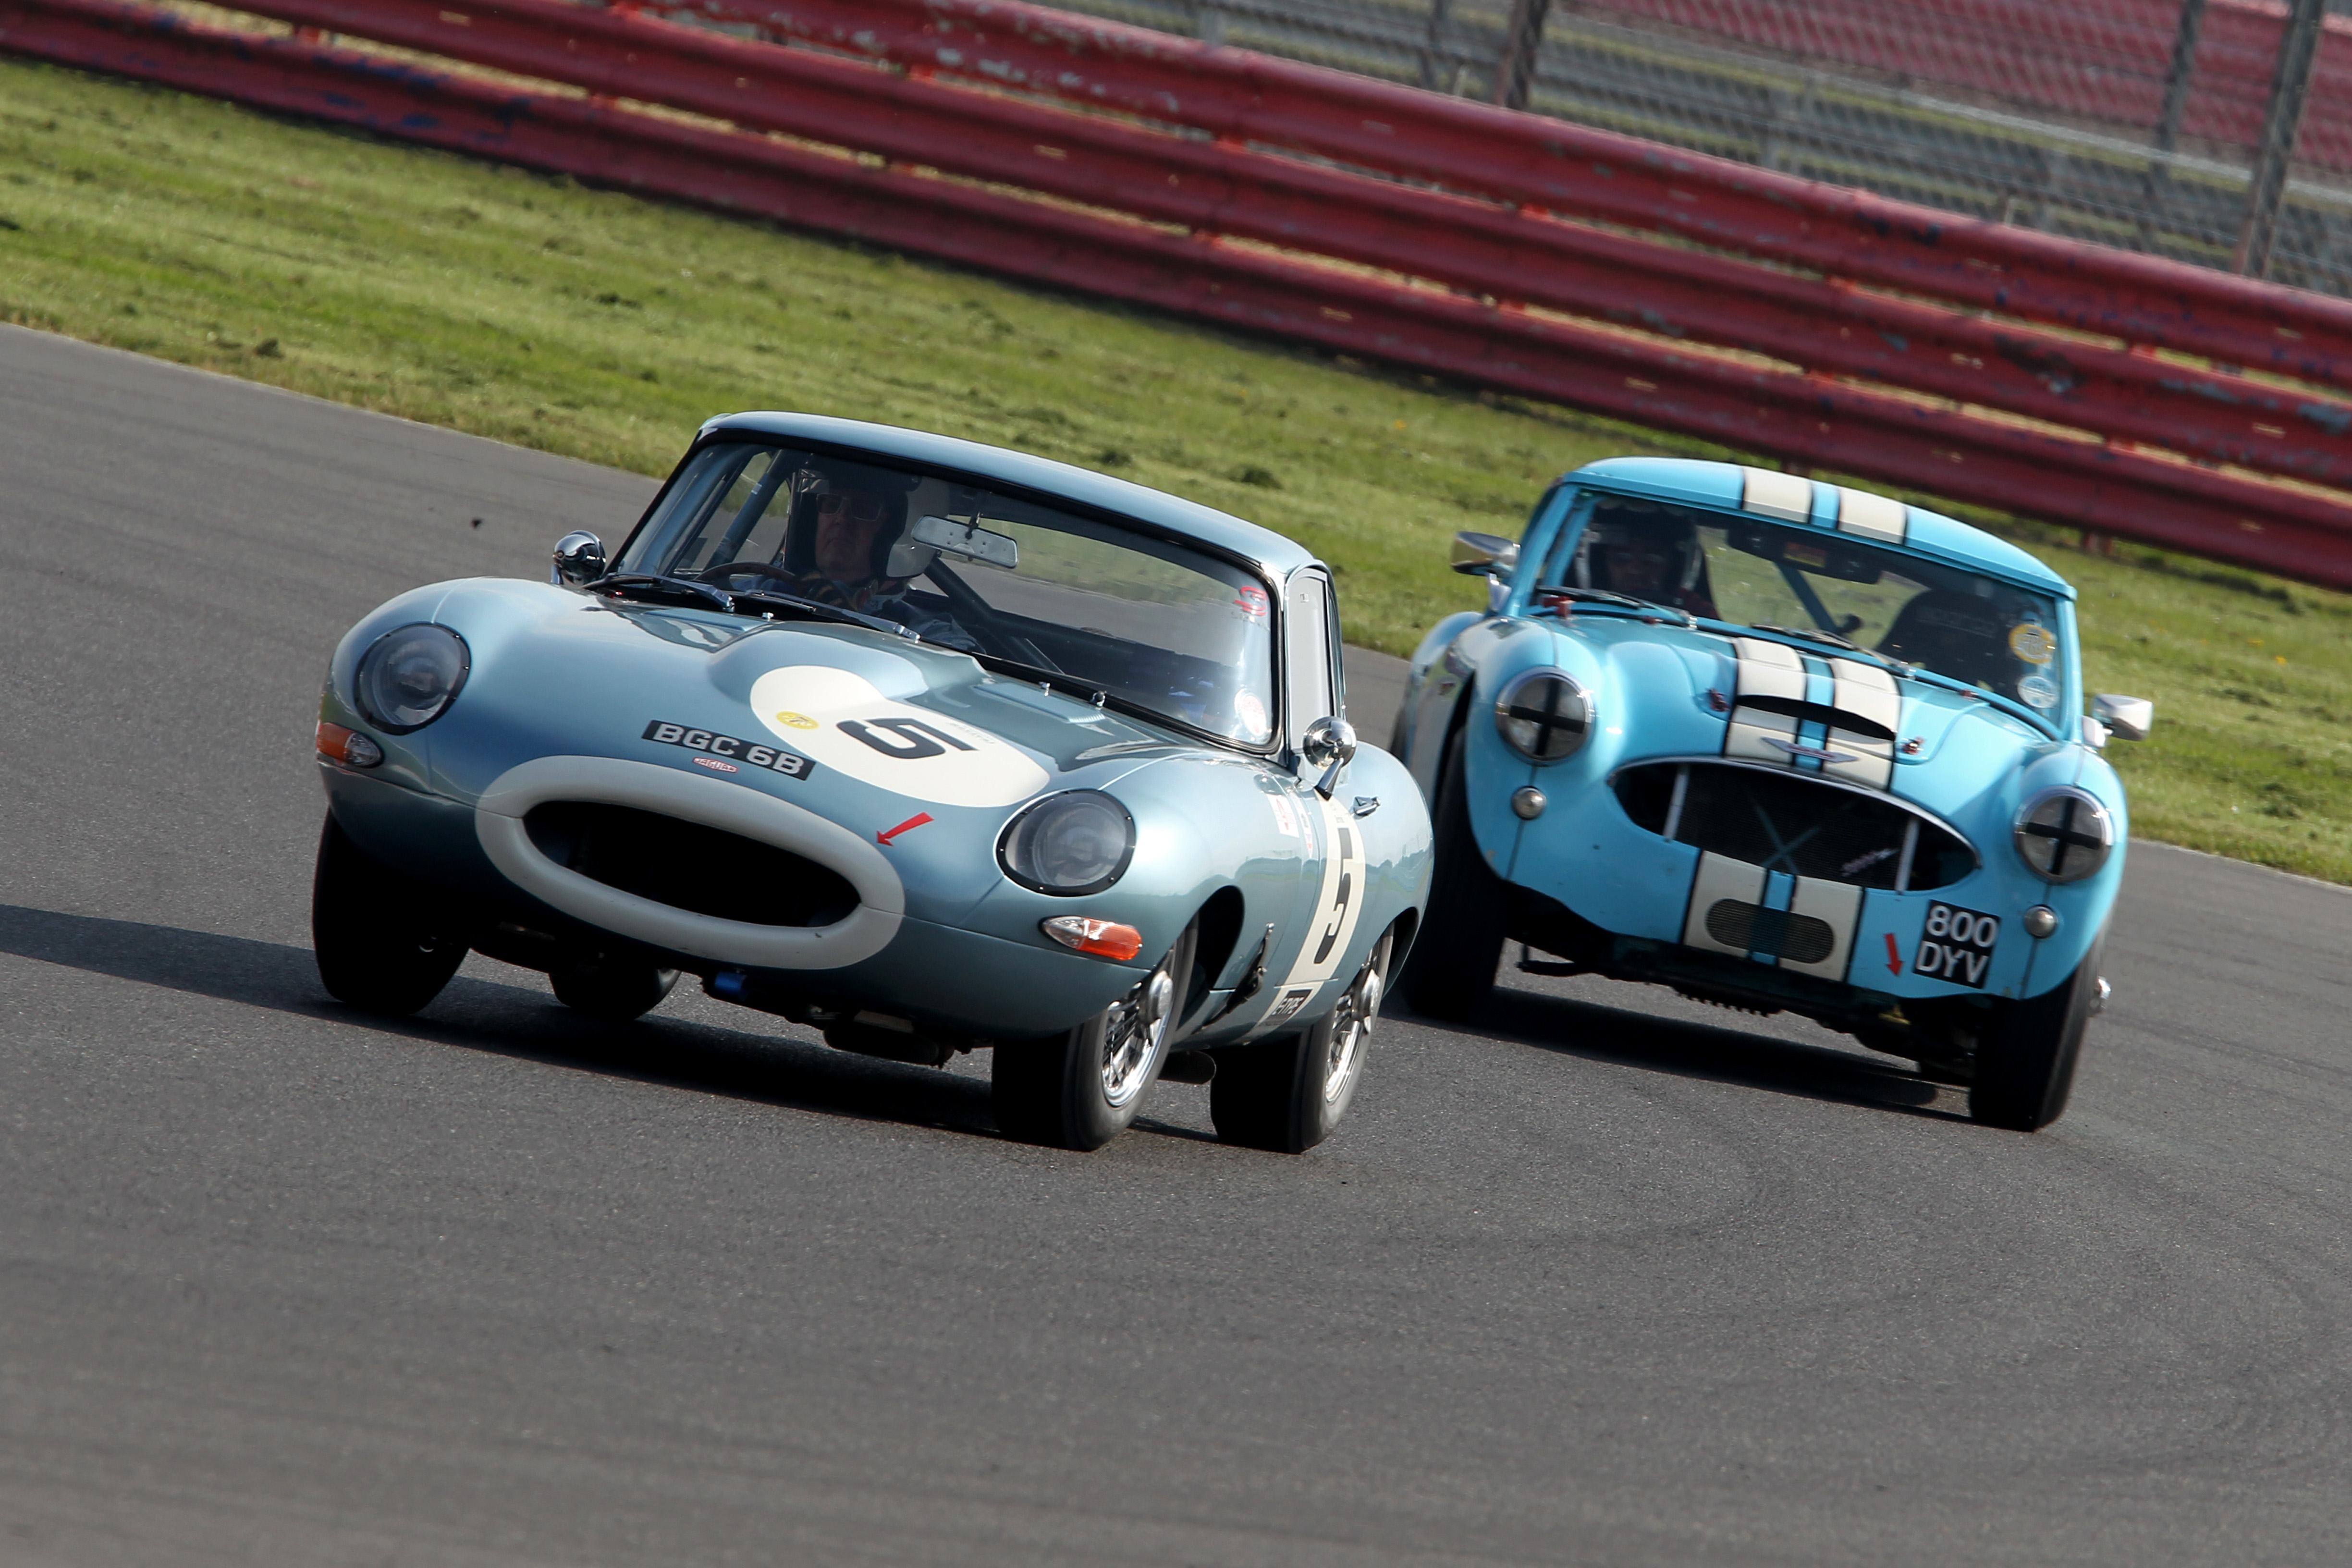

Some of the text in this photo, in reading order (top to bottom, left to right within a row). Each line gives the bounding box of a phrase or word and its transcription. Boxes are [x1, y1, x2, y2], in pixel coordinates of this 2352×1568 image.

[652, 723, 804, 774] BGC 6B
[836, 718, 979, 759] 5
[1313, 828, 1353, 964] 5
[1926, 905, 1998, 947] 800
[1915, 940, 1989, 983] DYV
